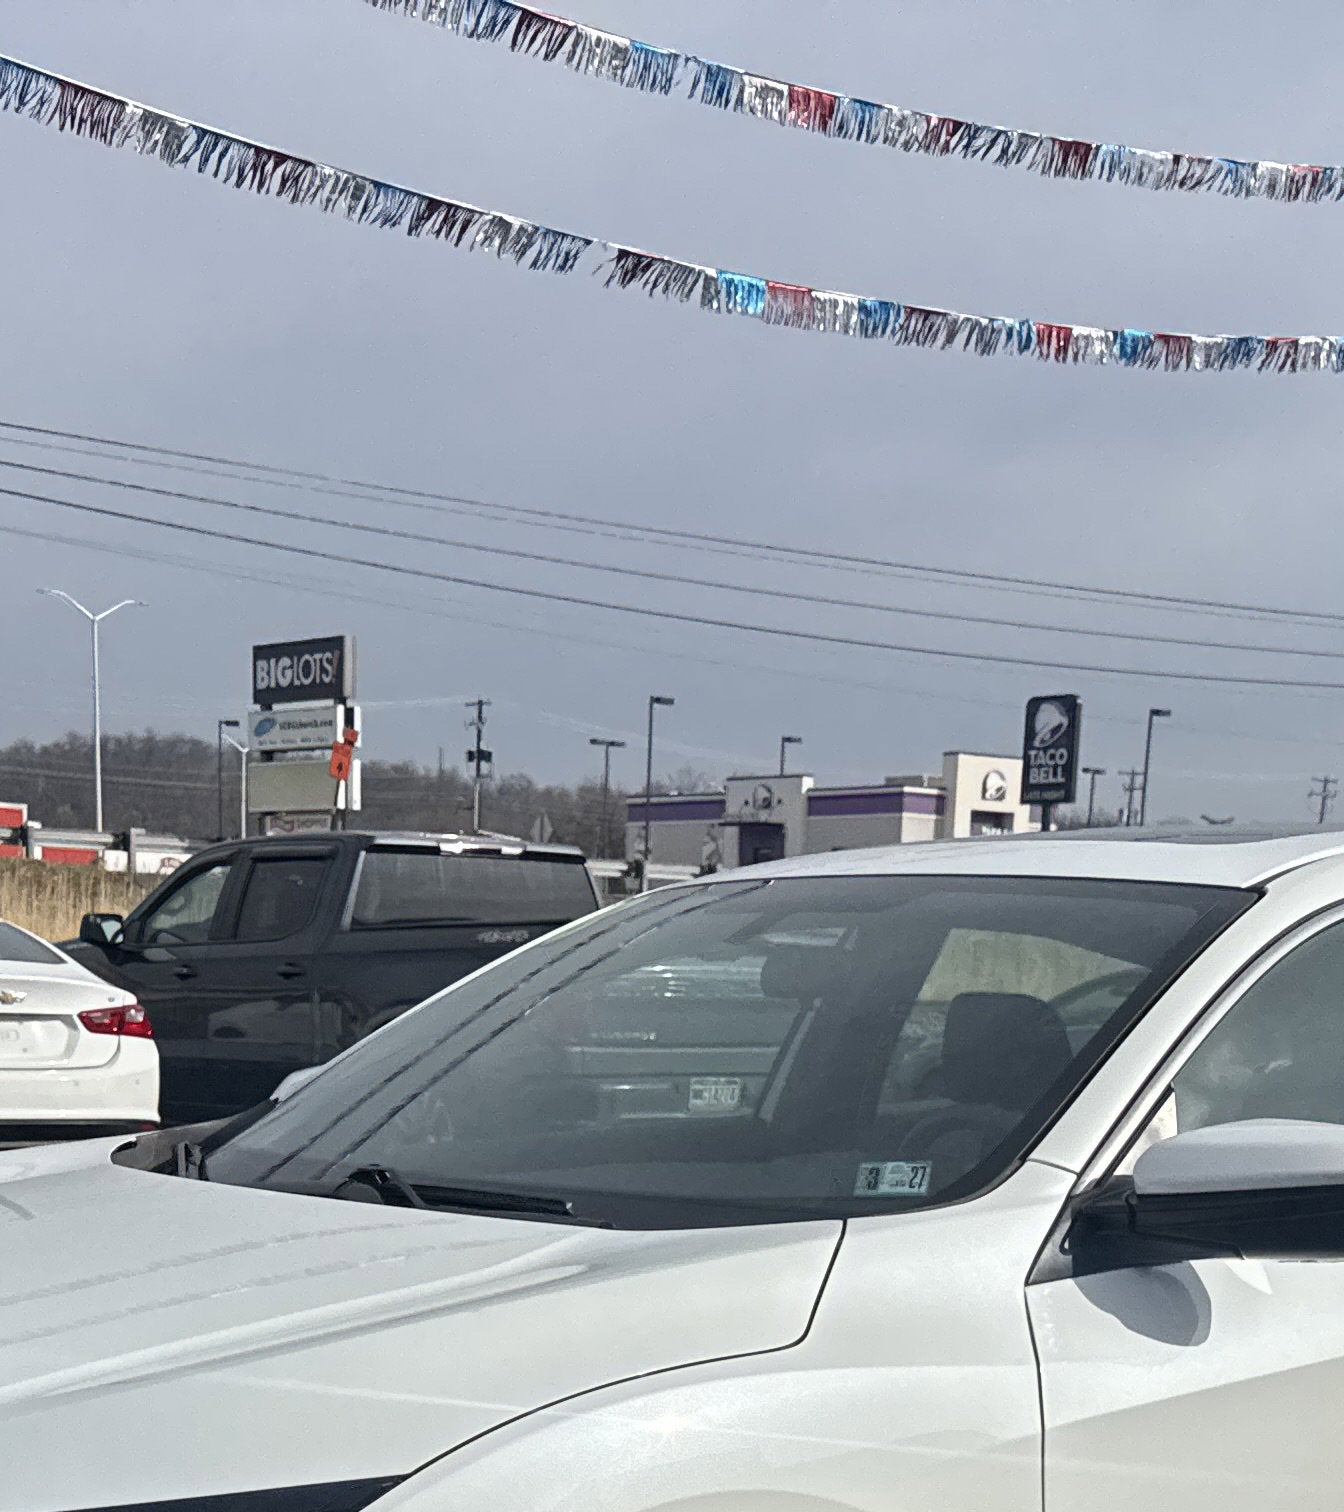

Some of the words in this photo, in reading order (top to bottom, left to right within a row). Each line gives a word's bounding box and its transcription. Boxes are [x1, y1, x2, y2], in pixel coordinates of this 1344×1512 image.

[1028, 748, 1068, 766] TACO
[1029, 765, 1065, 784] BELL
[909, 1166, 927, 1191] 27
